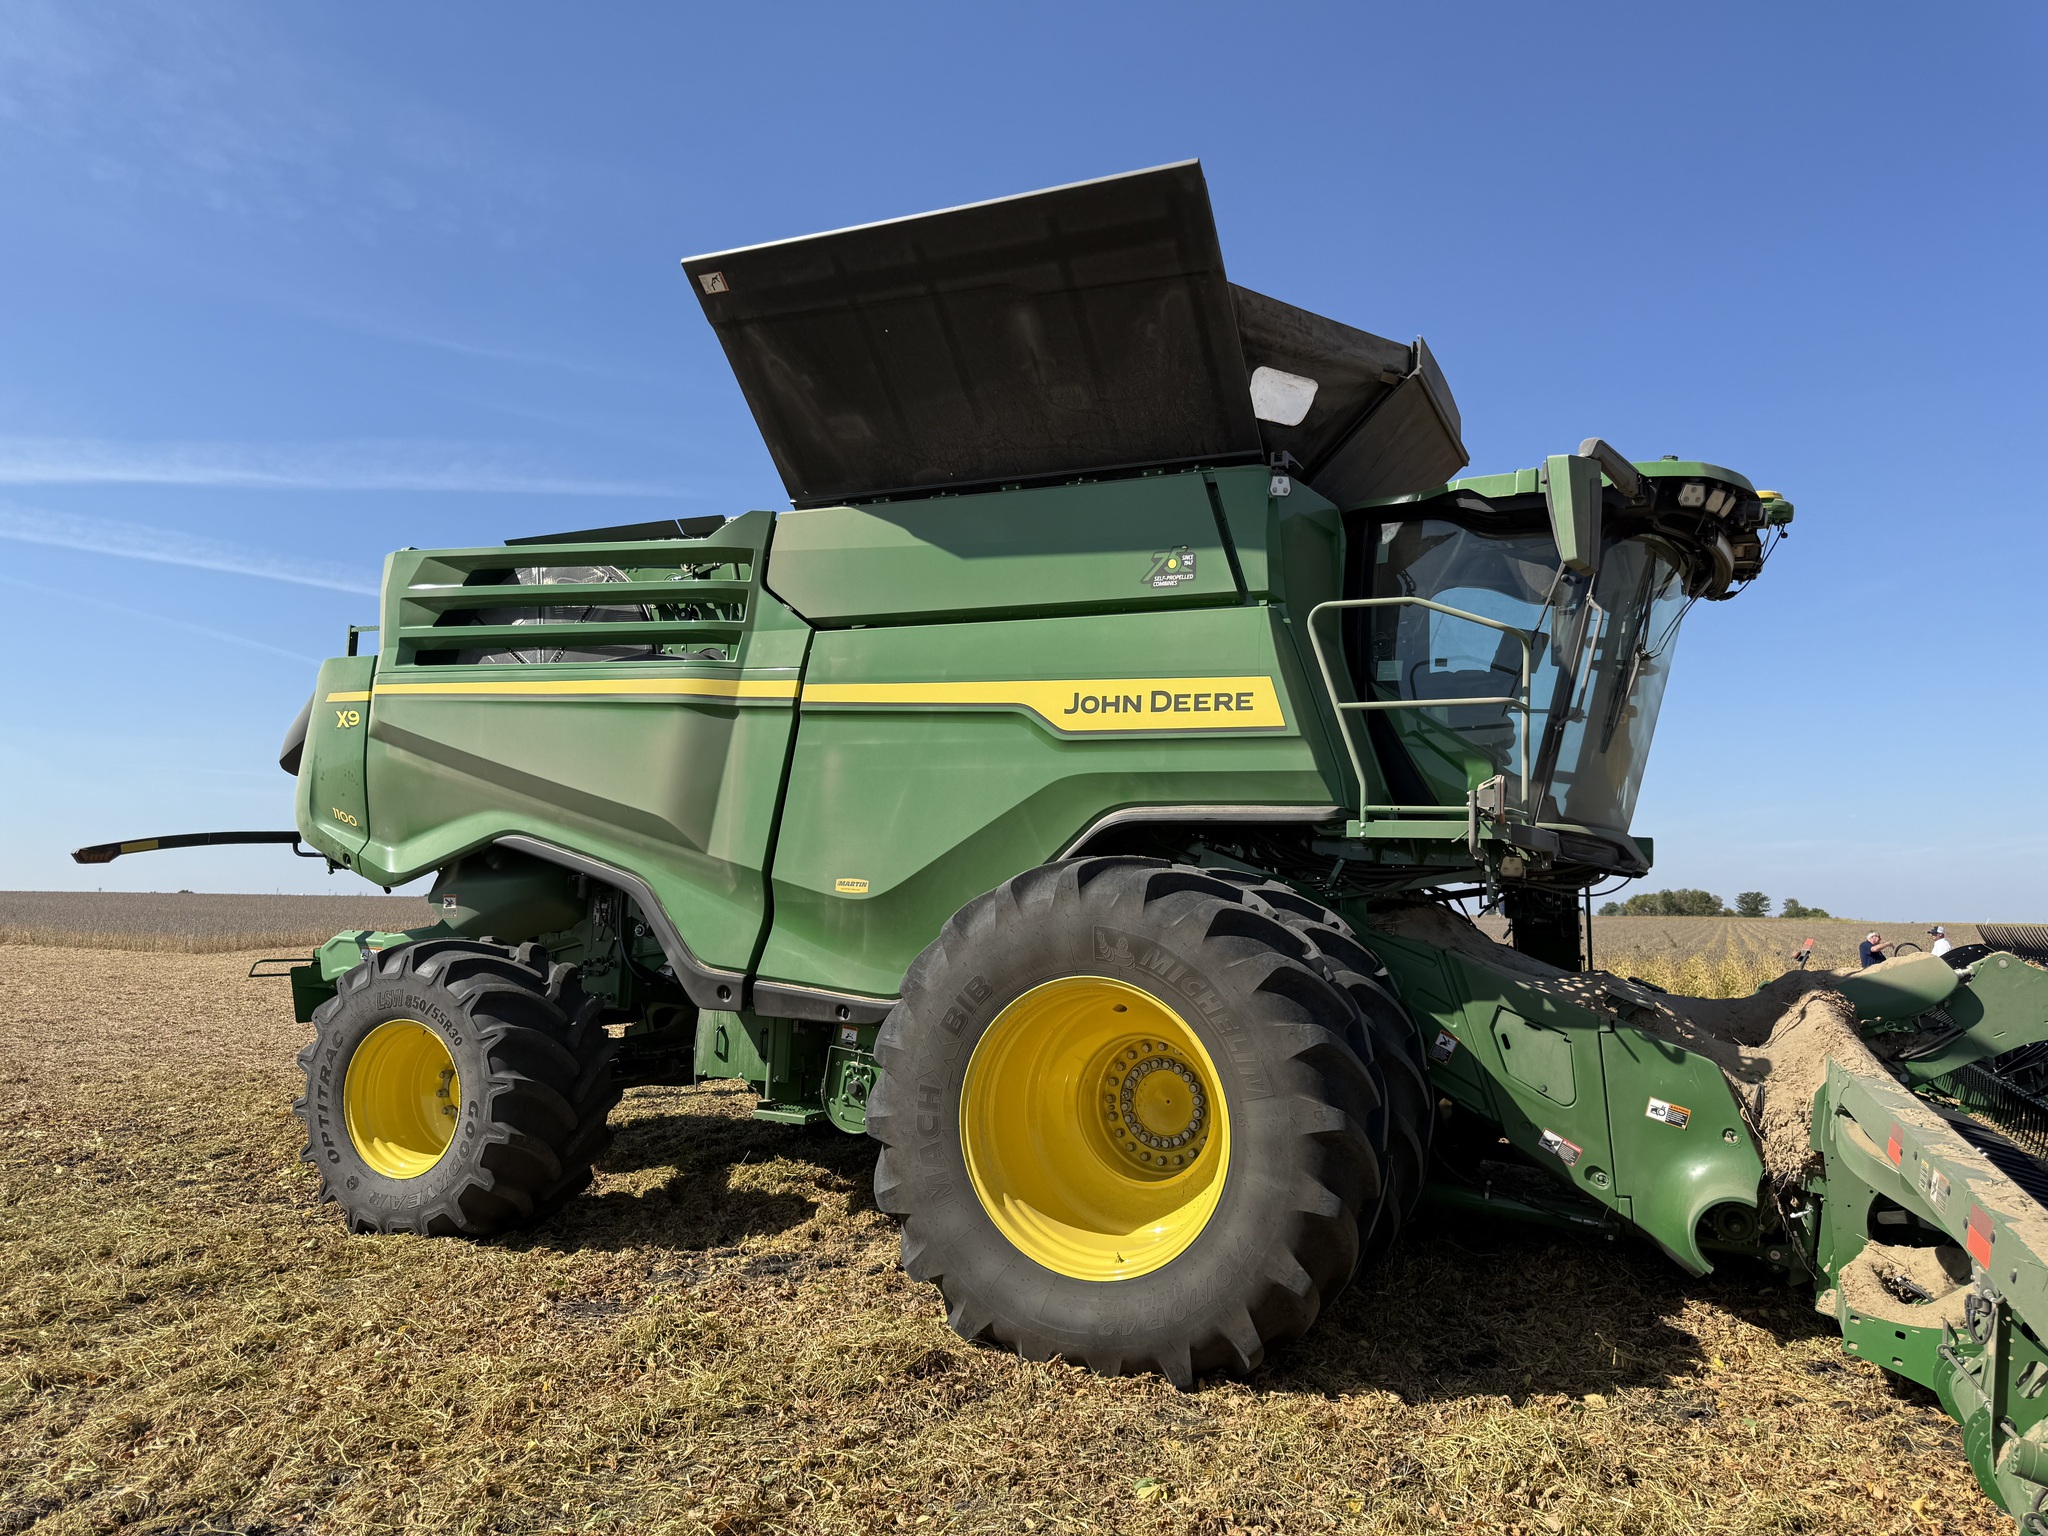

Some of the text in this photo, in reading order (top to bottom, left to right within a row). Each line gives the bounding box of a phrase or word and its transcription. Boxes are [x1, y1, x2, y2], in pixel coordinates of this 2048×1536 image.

[1064, 690, 1254, 715] JOHN DEERE
[336, 710, 360, 728] X9
[332, 807, 358, 827] 1100
[1139, 946, 1267, 1095] MICHELIN
[317, 1029, 344, 1165] OPTITRAC
